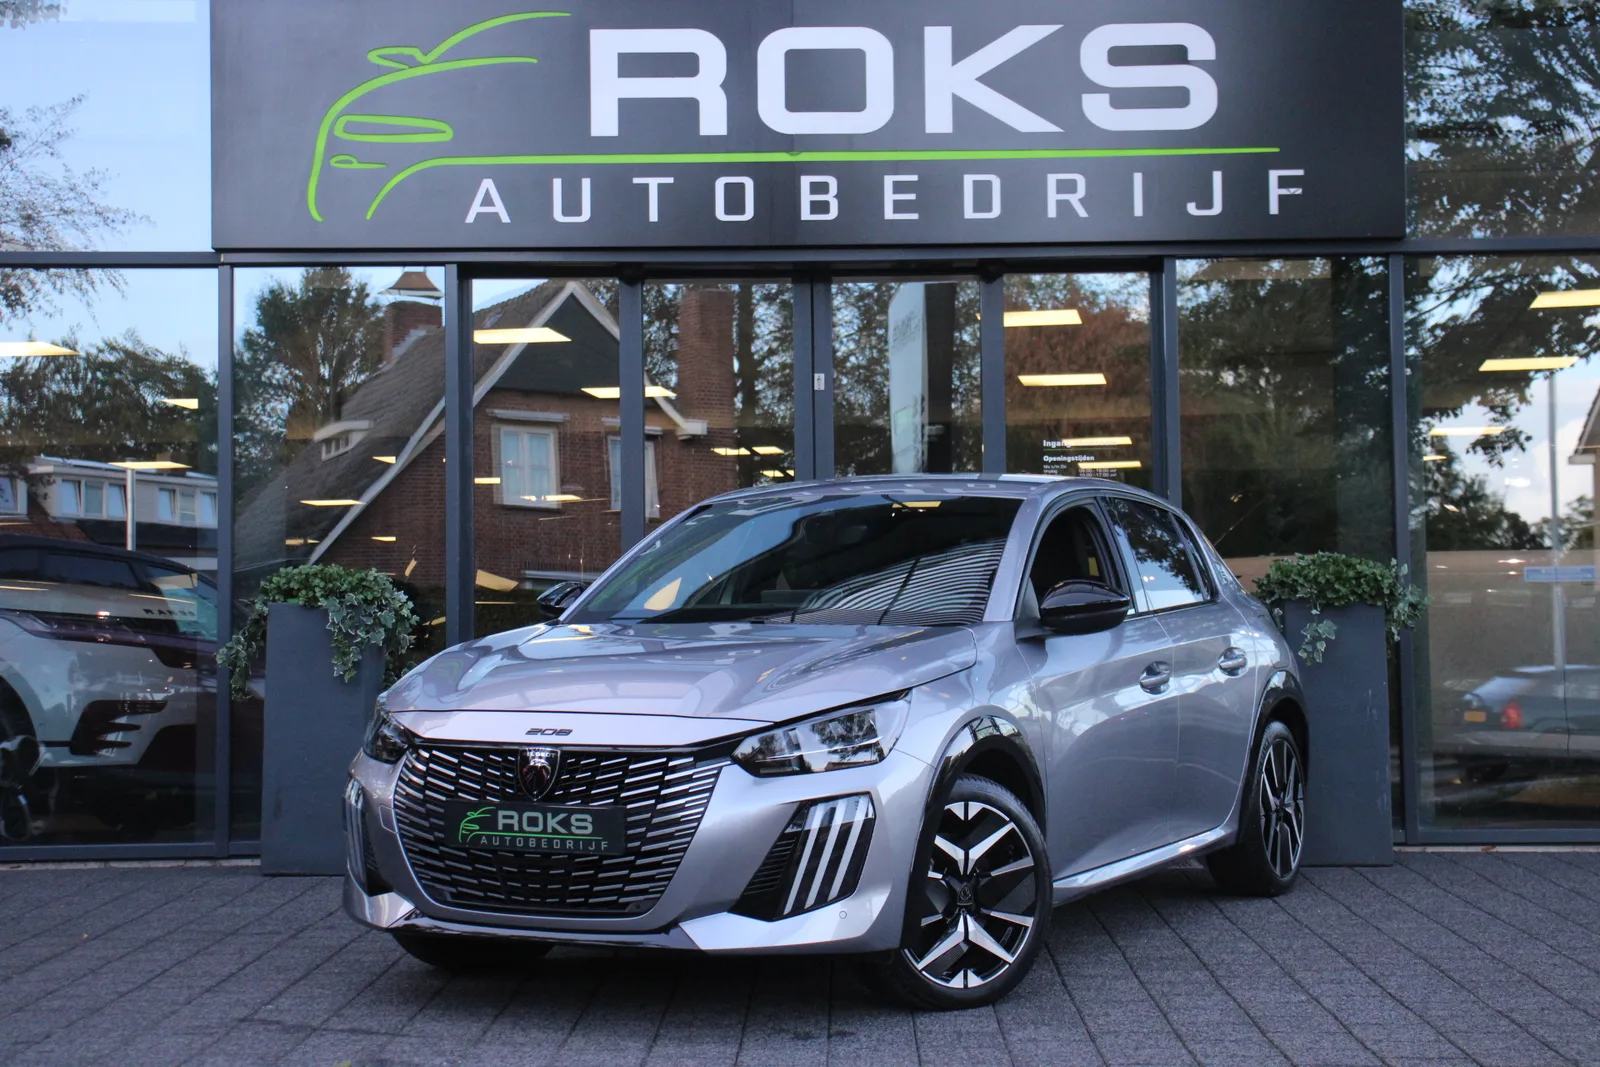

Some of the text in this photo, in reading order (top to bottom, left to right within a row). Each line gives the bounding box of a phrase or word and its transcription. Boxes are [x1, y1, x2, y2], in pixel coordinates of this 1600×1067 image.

[588, 23, 1219, 137] ROKS
[464, 168, 1306, 225] AUTOBEDRIJF
[525, 728, 573, 736] 208
[497, 809, 593, 834] ROKS
[480, 836, 609, 851] AUTOBEDRIJF
